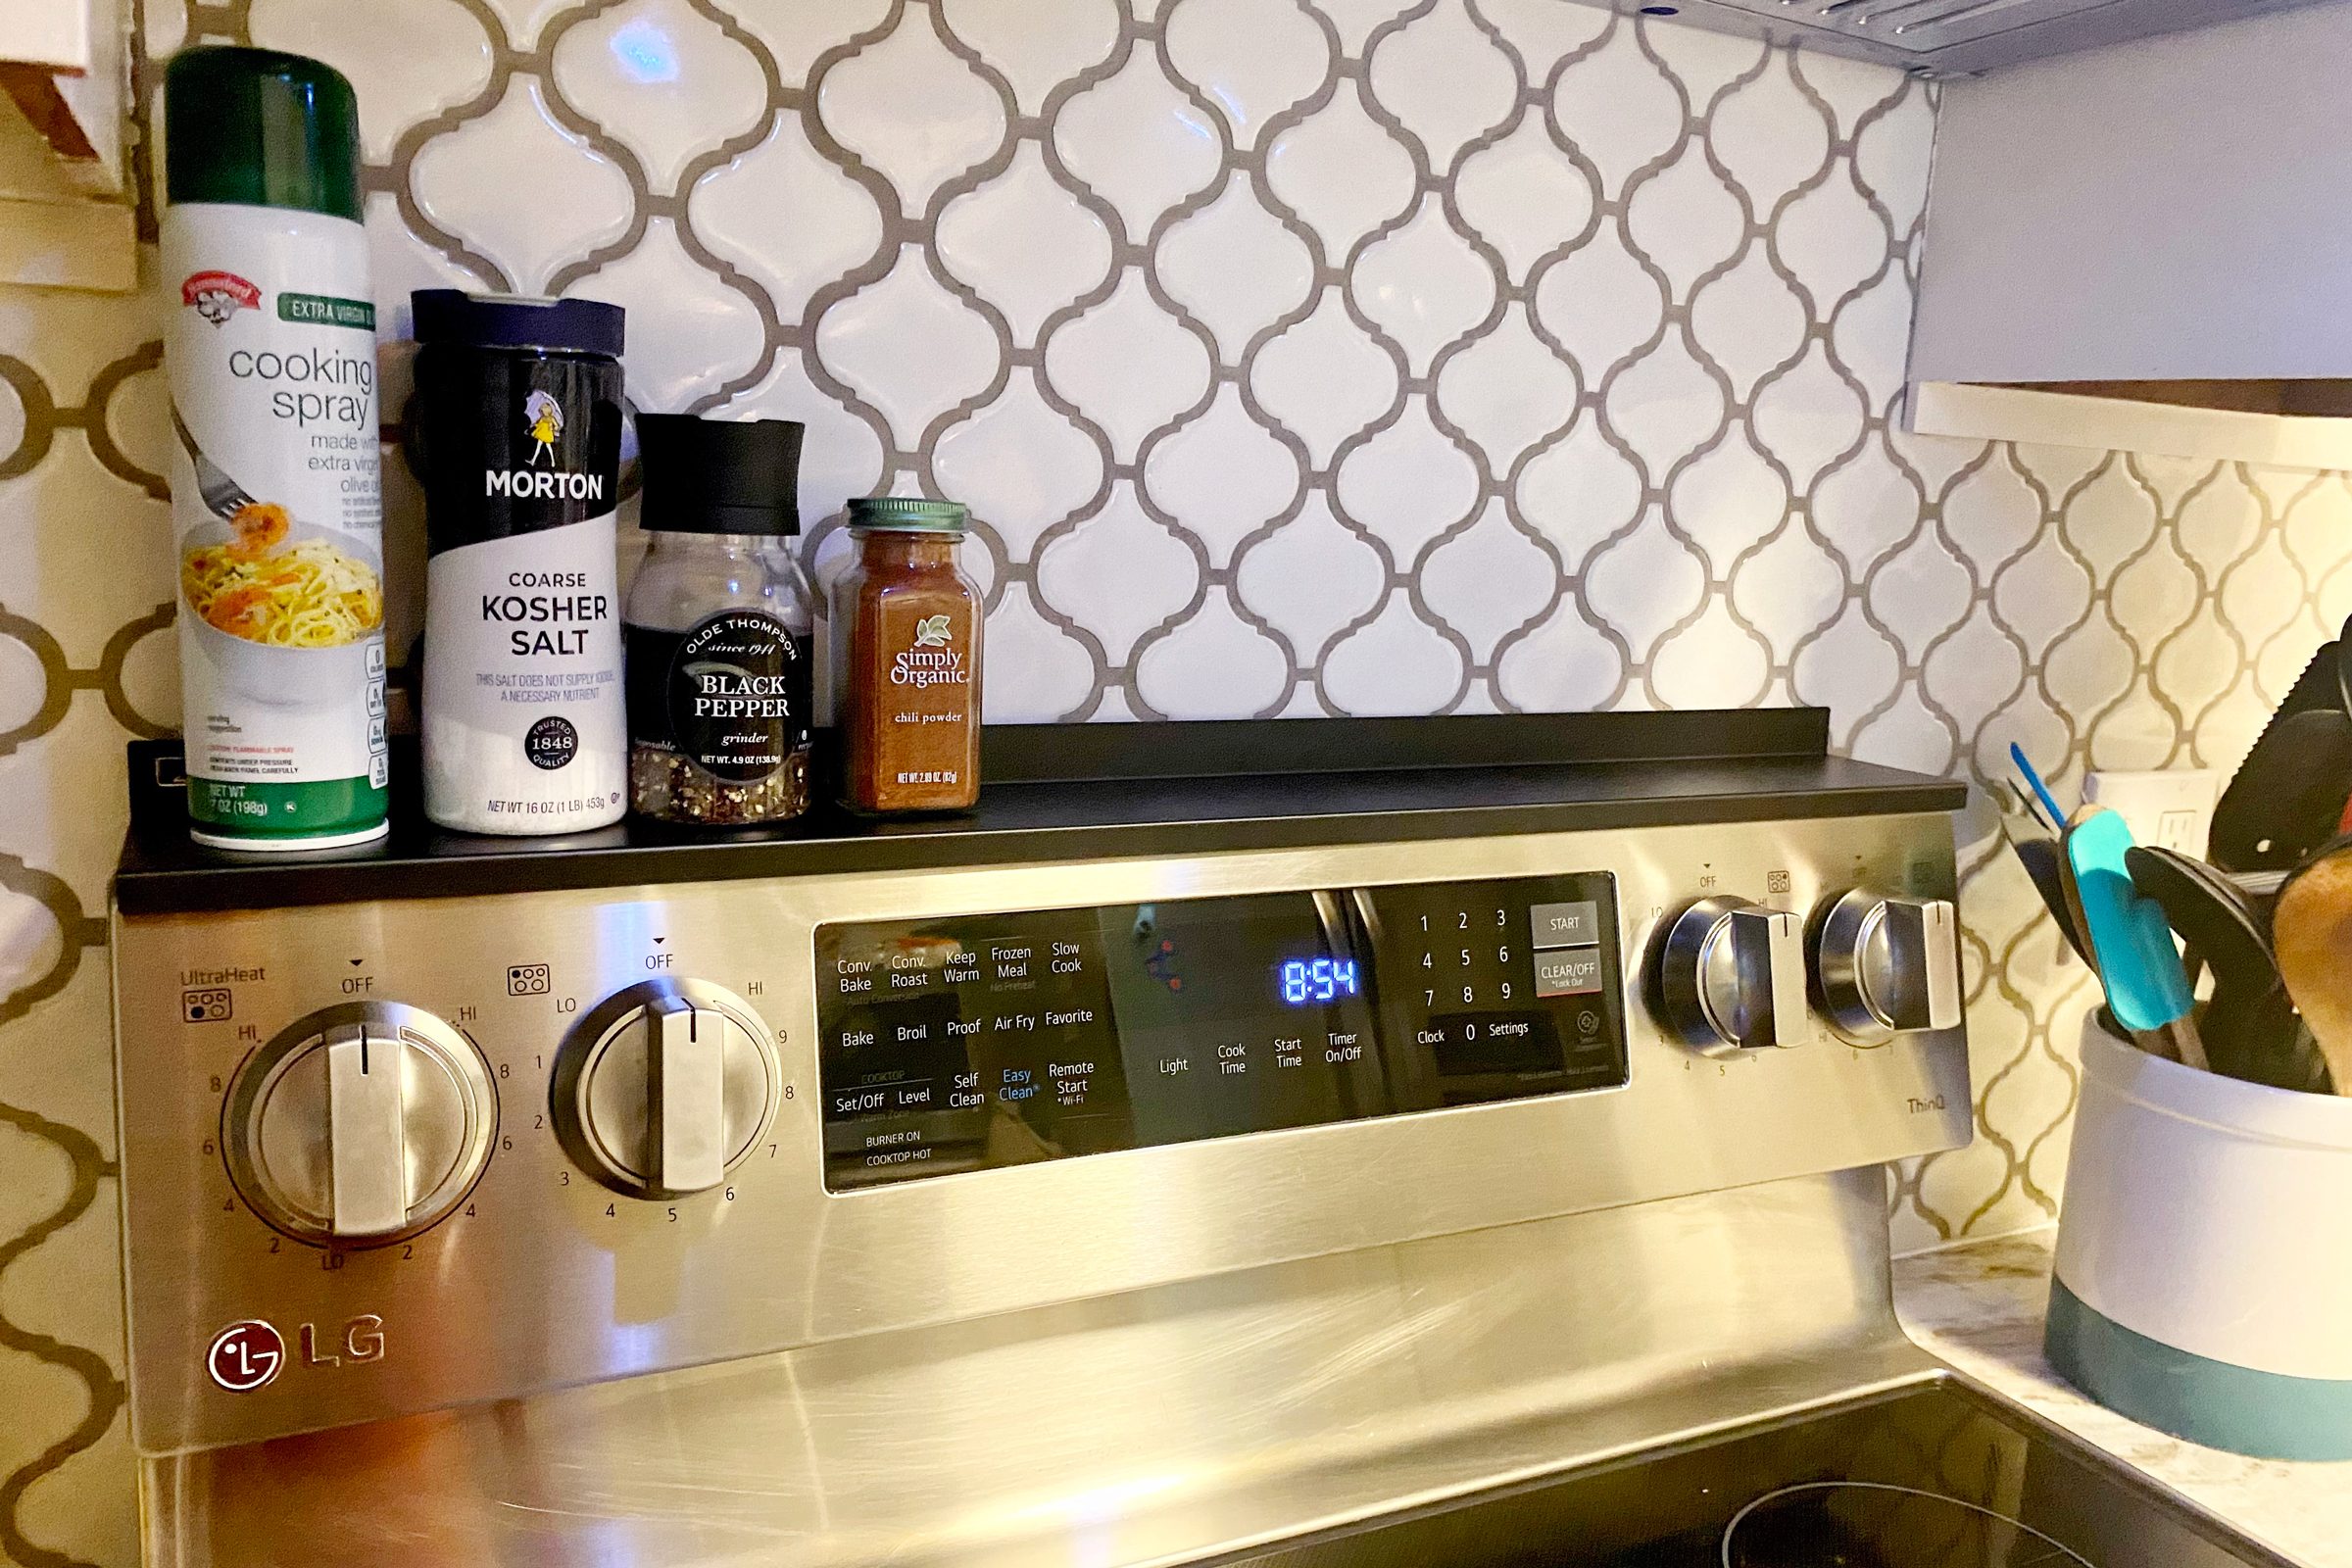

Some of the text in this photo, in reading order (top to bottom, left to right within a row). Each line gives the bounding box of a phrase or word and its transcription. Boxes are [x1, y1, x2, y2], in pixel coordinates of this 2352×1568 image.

[293, 301, 334, 318] EXTRA
[229, 348, 372, 395] cooking
[272, 392, 368, 431] spray
[311, 433, 358, 450] made
[308, 456, 350, 471] extra
[340, 477, 369, 493] olive
[485, 469, 604, 500] MORTON
[509, 572, 587, 588] COARSE
[481, 594, 608, 622] KOSHER
[511, 628, 589, 656] SALT
[686, 618, 797, 661] OLDE THOMPSON
[708, 643, 746, 653] since
[896, 648, 962, 670] Simply
[476, 673, 494, 686] THIS
[496, 674, 515, 687] SALT
[518, 674, 544, 687] DOES
[545, 674, 564, 687] NOT
[565, 672, 594, 686] SUPPLY
[701, 674, 786, 695] BLACK
[500, 687, 600, 703] A NECESSARY NUTRIENT
[694, 697, 790, 717] PEPPER
[895, 712, 961, 724] chili powder
[532, 719, 571, 736] TRUSTED
[532, 736, 573, 752] 1848
[720, 732, 768, 746] grinder
[532, 753, 570, 767] QUALITY
[701, 755, 715, 763] NET
[716, 756, 731, 764] WT.
[732, 756, 744, 764] 4.9
[745, 756, 755, 764] OZ
[897, 772, 908, 783] NET
[229, 786, 245, 798] WT
[218, 800, 231, 812] OZ
[233, 800, 268, 816] (198g)
[487, 797, 605, 814] NET WT 16 OZ (1 LB) 453g
[1699, 875, 1716, 888] OFF
[1421, 909, 1505, 931] 1 2 3
[1651, 906, 1663, 918] LO
[1549, 916, 1580, 931] START
[991, 947, 1032, 961] Frozen
[1052, 942, 1079, 956] Slow
[645, 954, 674, 970] OFF
[892, 955, 926, 970] Conv.
[946, 951, 976, 968] Keep
[1423, 946, 1508, 969] 4 5 6
[837, 959, 872, 974] Conv.
[998, 962, 1027, 978] Meal
[1052, 958, 1082, 974] Cook
[1541, 962, 1595, 979] CLEAR/OFF
[180, 966, 266, 987] UltraHeat
[891, 972, 928, 988] Roast
[944, 968, 979, 983] Warm
[1284, 958, 1355, 1003] 8:54
[342, 976, 373, 994] OFF
[748, 981, 763, 996] HI
[840, 978, 872, 993] Bake
[1425, 983, 1510, 1006] 7 8 9
[557, 998, 576, 1012] LO
[460, 1006, 477, 1021] HI
[1046, 1008, 1093, 1026] Favorite
[947, 1019, 981, 1035] Proof
[995, 1014, 1035, 1031] Air Fry
[238, 1025, 257, 1041] HI
[778, 1030, 788, 1044] 9
[842, 1032, 874, 1047] Bake
[897, 1025, 927, 1041] Broil
[1328, 1033, 1357, 1046] Timer
[1418, 1022, 1529, 1045] Clock 0 Settings
[1274, 1038, 1301, 1052] Start
[1657, 1036, 1664, 1047] 3
[1218, 1043, 1246, 1058] Cook
[1325, 1046, 1362, 1063] On/Off
[536, 1054, 542, 1069] 1
[1159, 1058, 1189, 1076] Light
[1219, 1060, 1246, 1075] Time
[1276, 1054, 1301, 1067] Time
[1684, 1059, 1690, 1071] 4
[500, 1064, 510, 1079] 8
[1003, 1068, 1032, 1084] Easy
[1049, 1061, 1095, 1077] Remote
[1719, 1065, 1726, 1077] 5
[211, 1078, 221, 1093] 8
[955, 1072, 979, 1089] Self
[1056, 1079, 1088, 1095] Start
[785, 1086, 795, 1100] 8
[899, 1087, 930, 1105] Level
[950, 1091, 985, 1108] Clean
[836, 1093, 884, 1112] Set/Off
[1907, 1094, 1945, 1113] ThinQ
[534, 1114, 543, 1129] 2
[502, 1136, 512, 1151] 6
[865, 1130, 920, 1147] BURNER ON
[203, 1140, 214, 1155] 6
[768, 1144, 777, 1158] 7
[866, 1148, 931, 1166] COOKTOP HOT
[561, 1171, 569, 1186] 3
[725, 1187, 735, 1200] 6
[222, 1199, 234, 1213] 4
[466, 1203, 476, 1217] 4
[606, 1203, 615, 1217] 4
[668, 1207, 677, 1222] 5
[270, 1238, 280, 1252] 2
[403, 1245, 413, 1260] 2
[299, 1314, 384, 1369] LG
